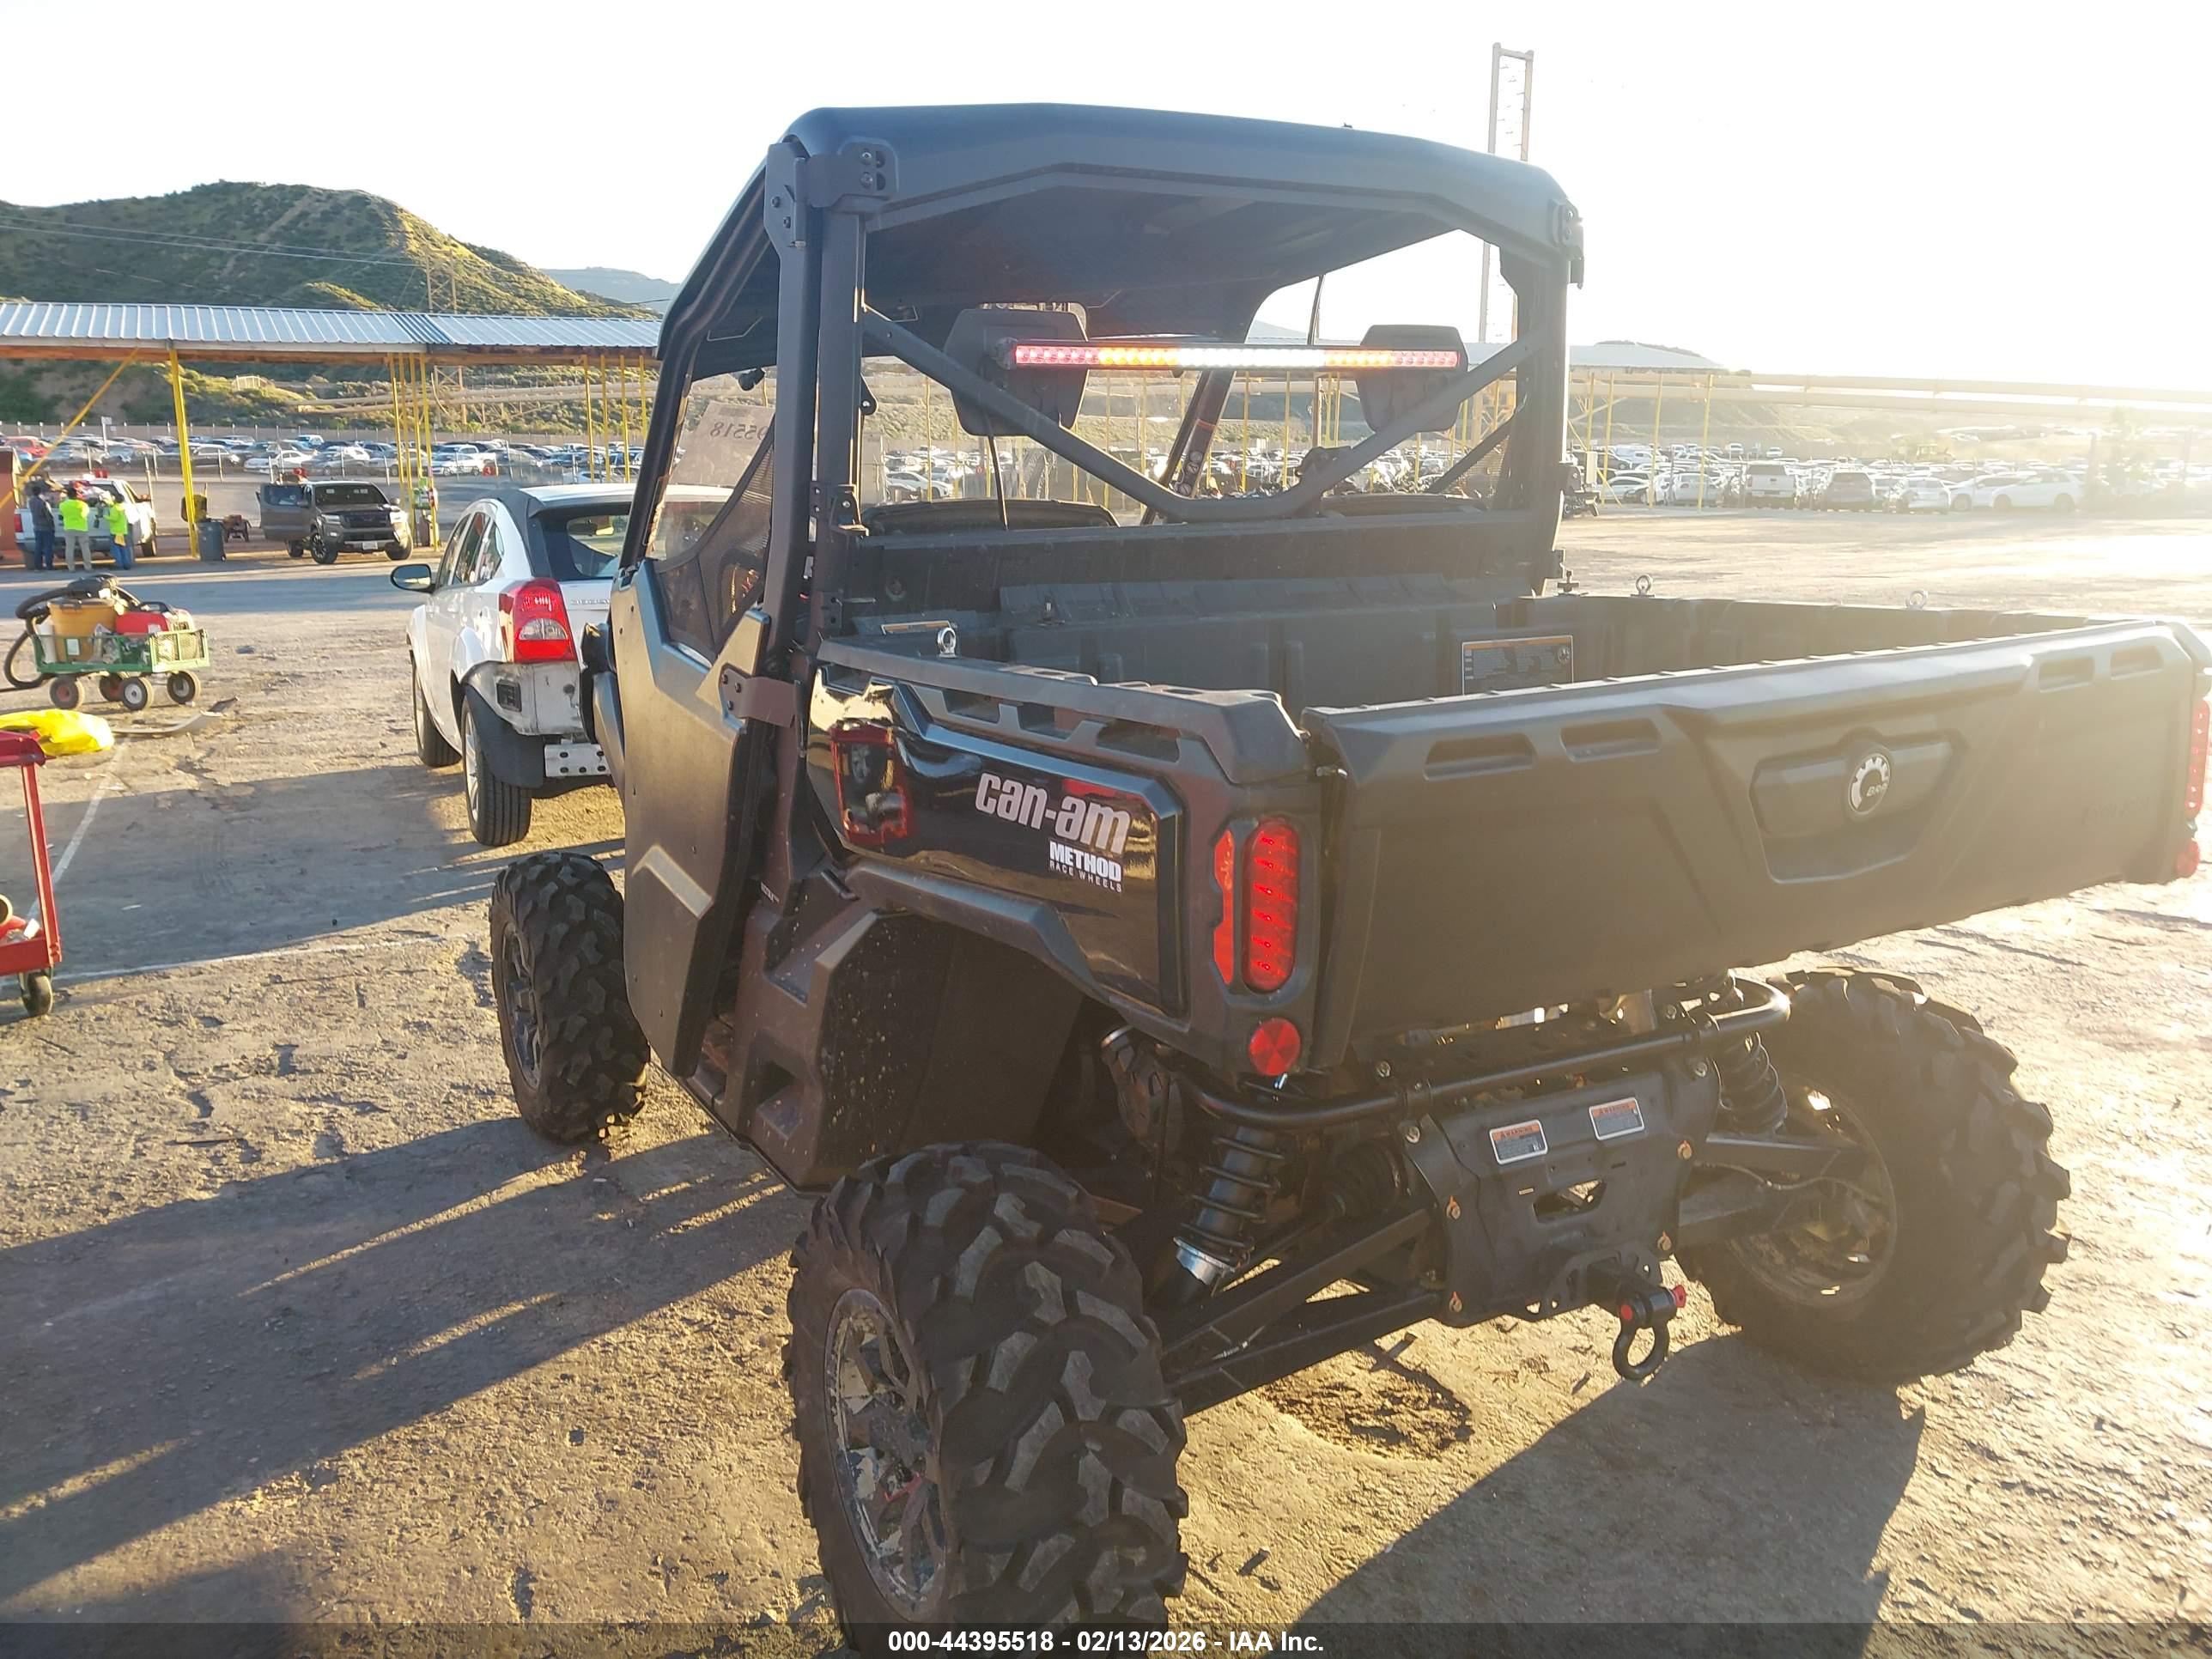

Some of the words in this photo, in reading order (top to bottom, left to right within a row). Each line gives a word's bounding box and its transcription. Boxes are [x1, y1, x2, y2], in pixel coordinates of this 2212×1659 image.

[975, 772, 1131, 855] can-am
[1049, 840, 1122, 882] METHOD
[1049, 860, 1074, 878] RACE
[1079, 869, 1122, 893] WHEELS
